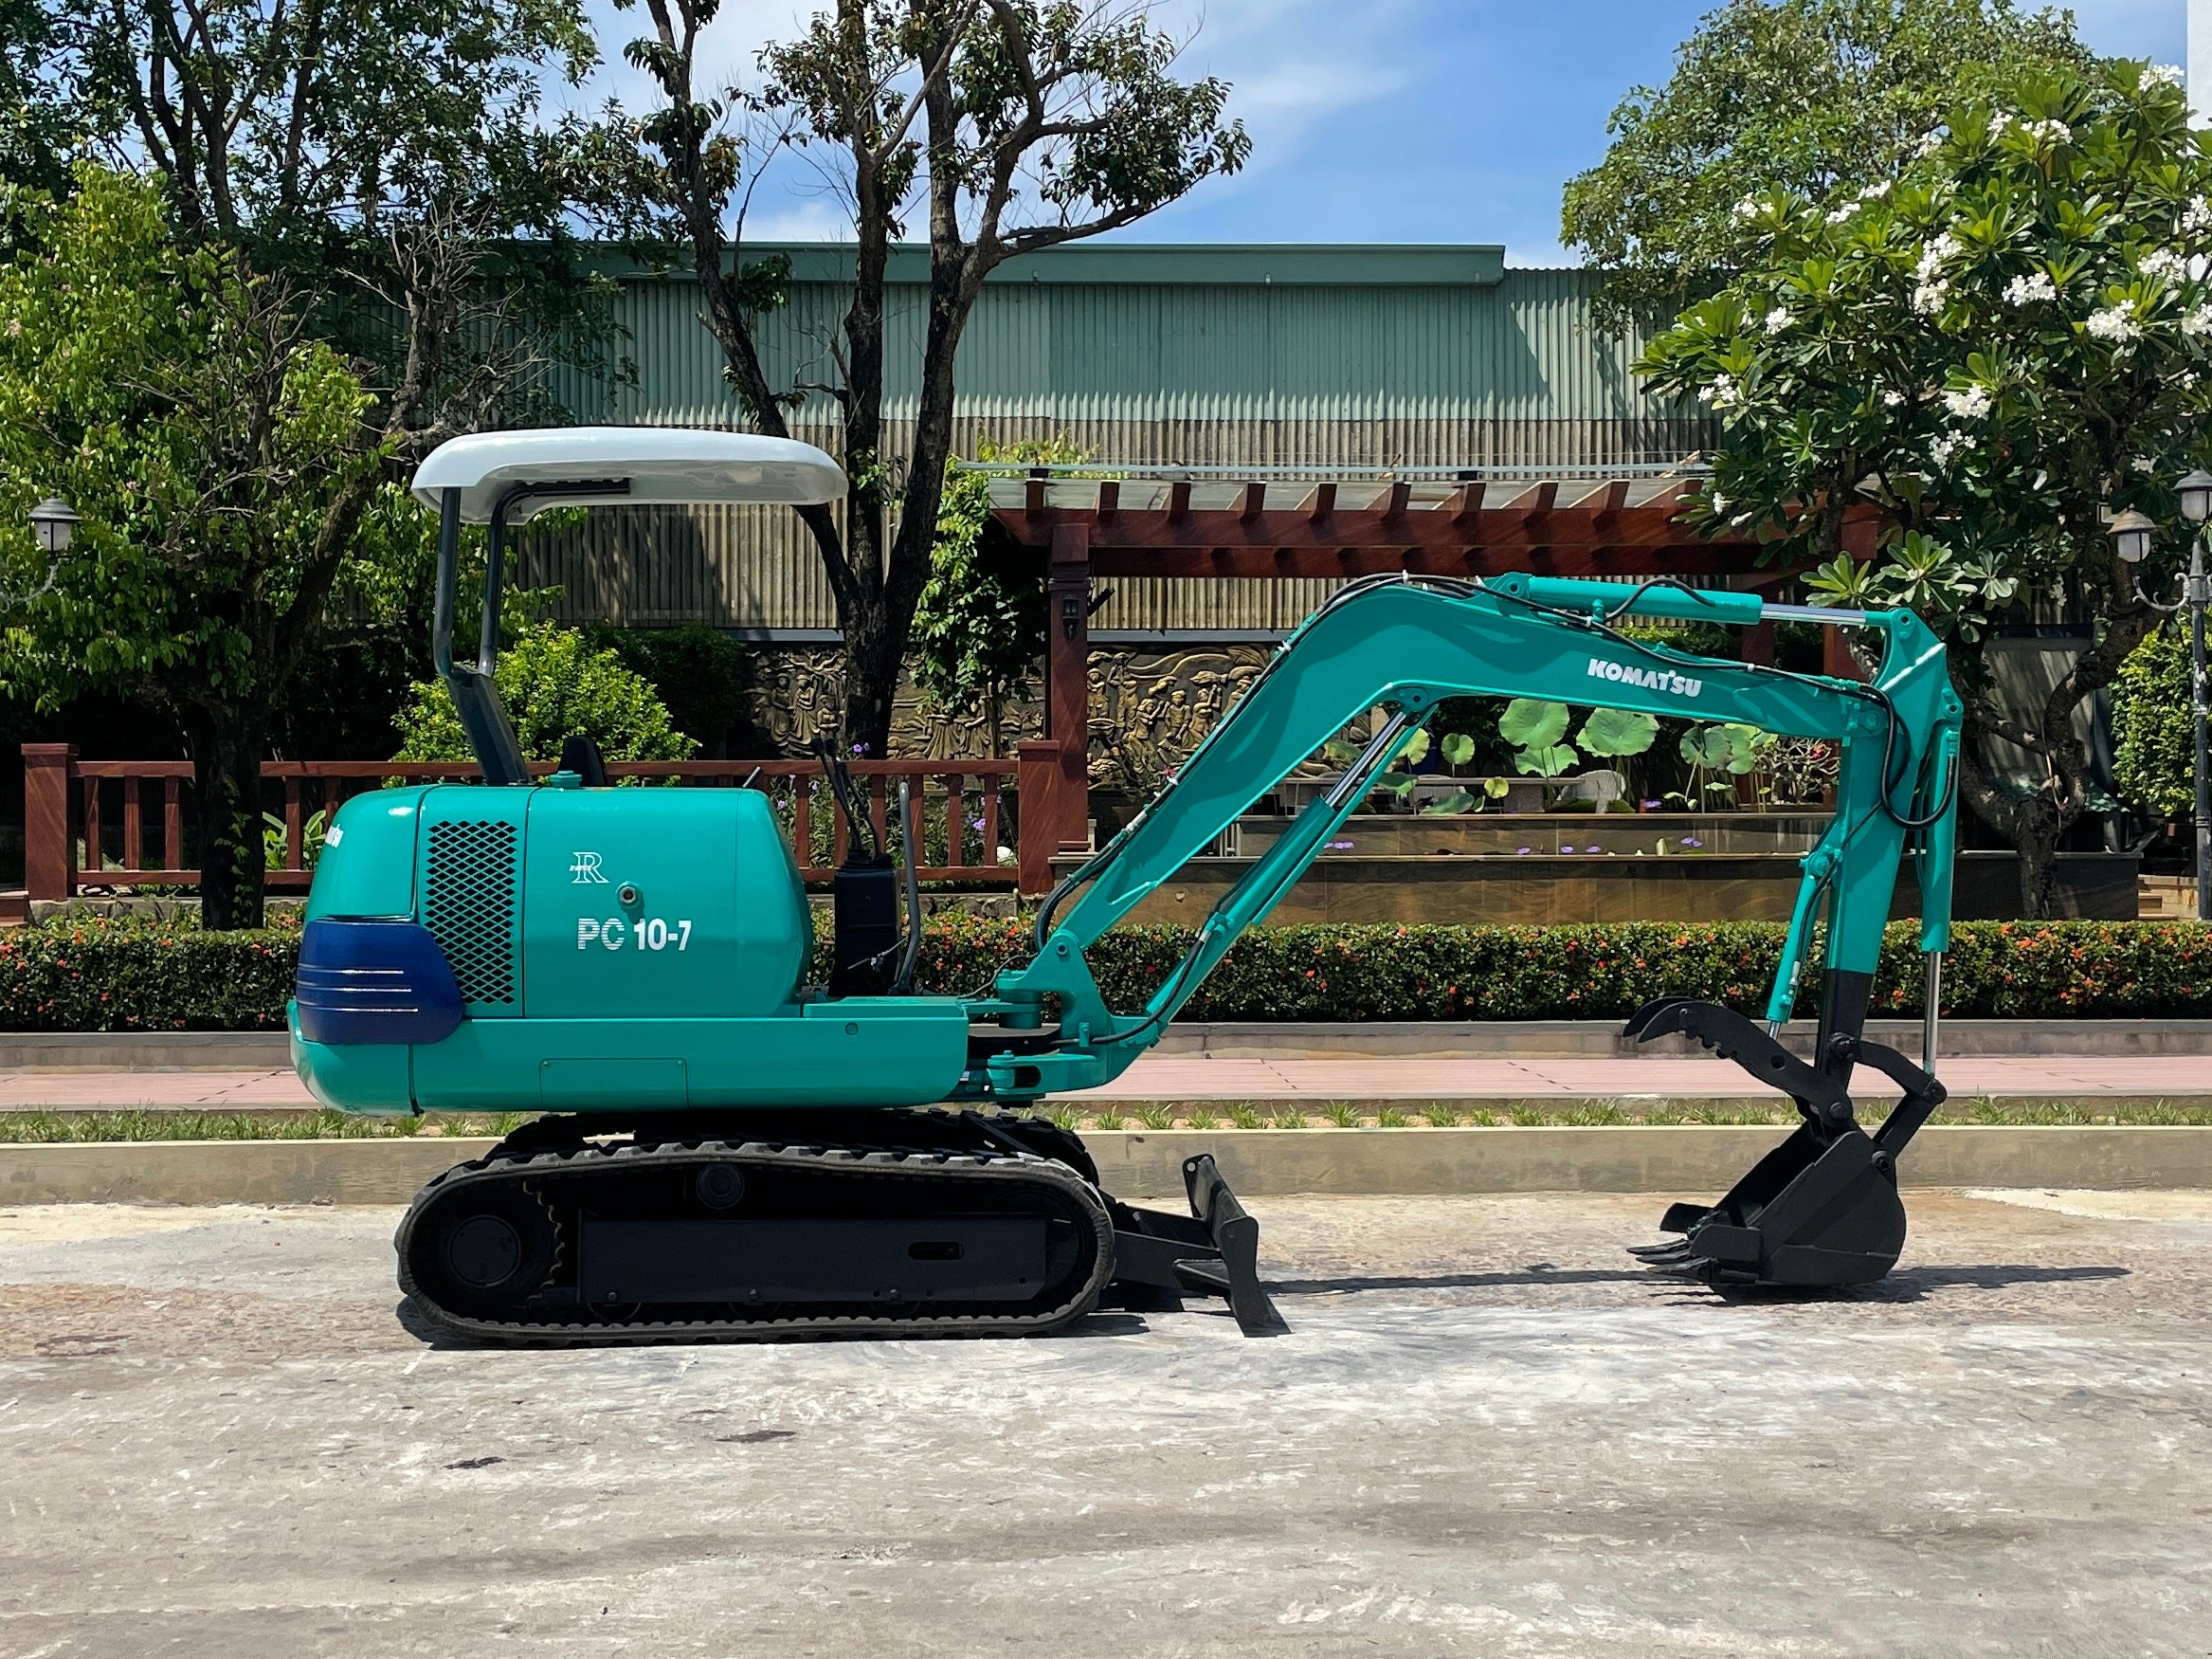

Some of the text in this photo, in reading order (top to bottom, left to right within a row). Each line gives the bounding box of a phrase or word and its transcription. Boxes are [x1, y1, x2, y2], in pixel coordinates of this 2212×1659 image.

[1586, 658, 1703, 698] KOMATSU
[577, 918, 692, 951] PC 10-7
